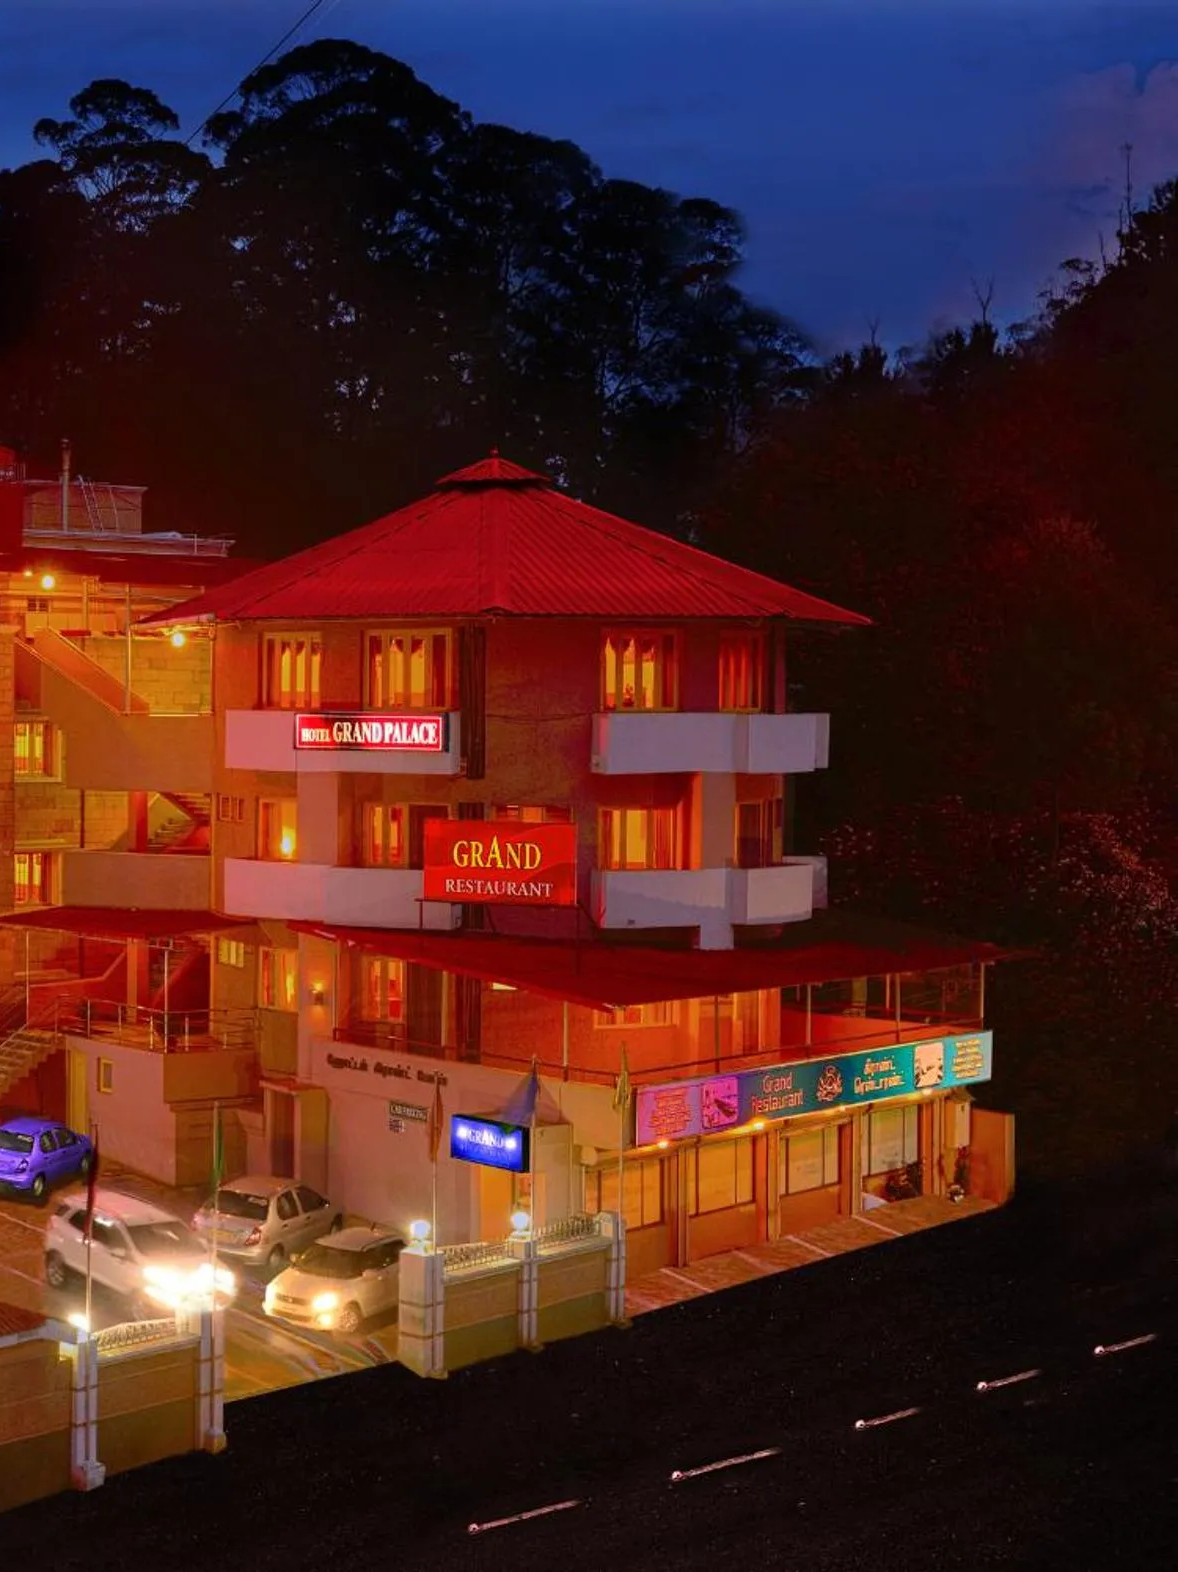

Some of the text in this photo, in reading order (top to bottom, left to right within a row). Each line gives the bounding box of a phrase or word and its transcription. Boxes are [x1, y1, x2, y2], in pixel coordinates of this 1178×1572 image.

[301, 721, 438, 744] HOTEL GRAND PALACE
[452, 836, 541, 870] GRAND
[445, 878, 553, 898] RESTAURANT
[762, 1072, 792, 1093] Grand
[752, 1088, 803, 1113] Restaurant
